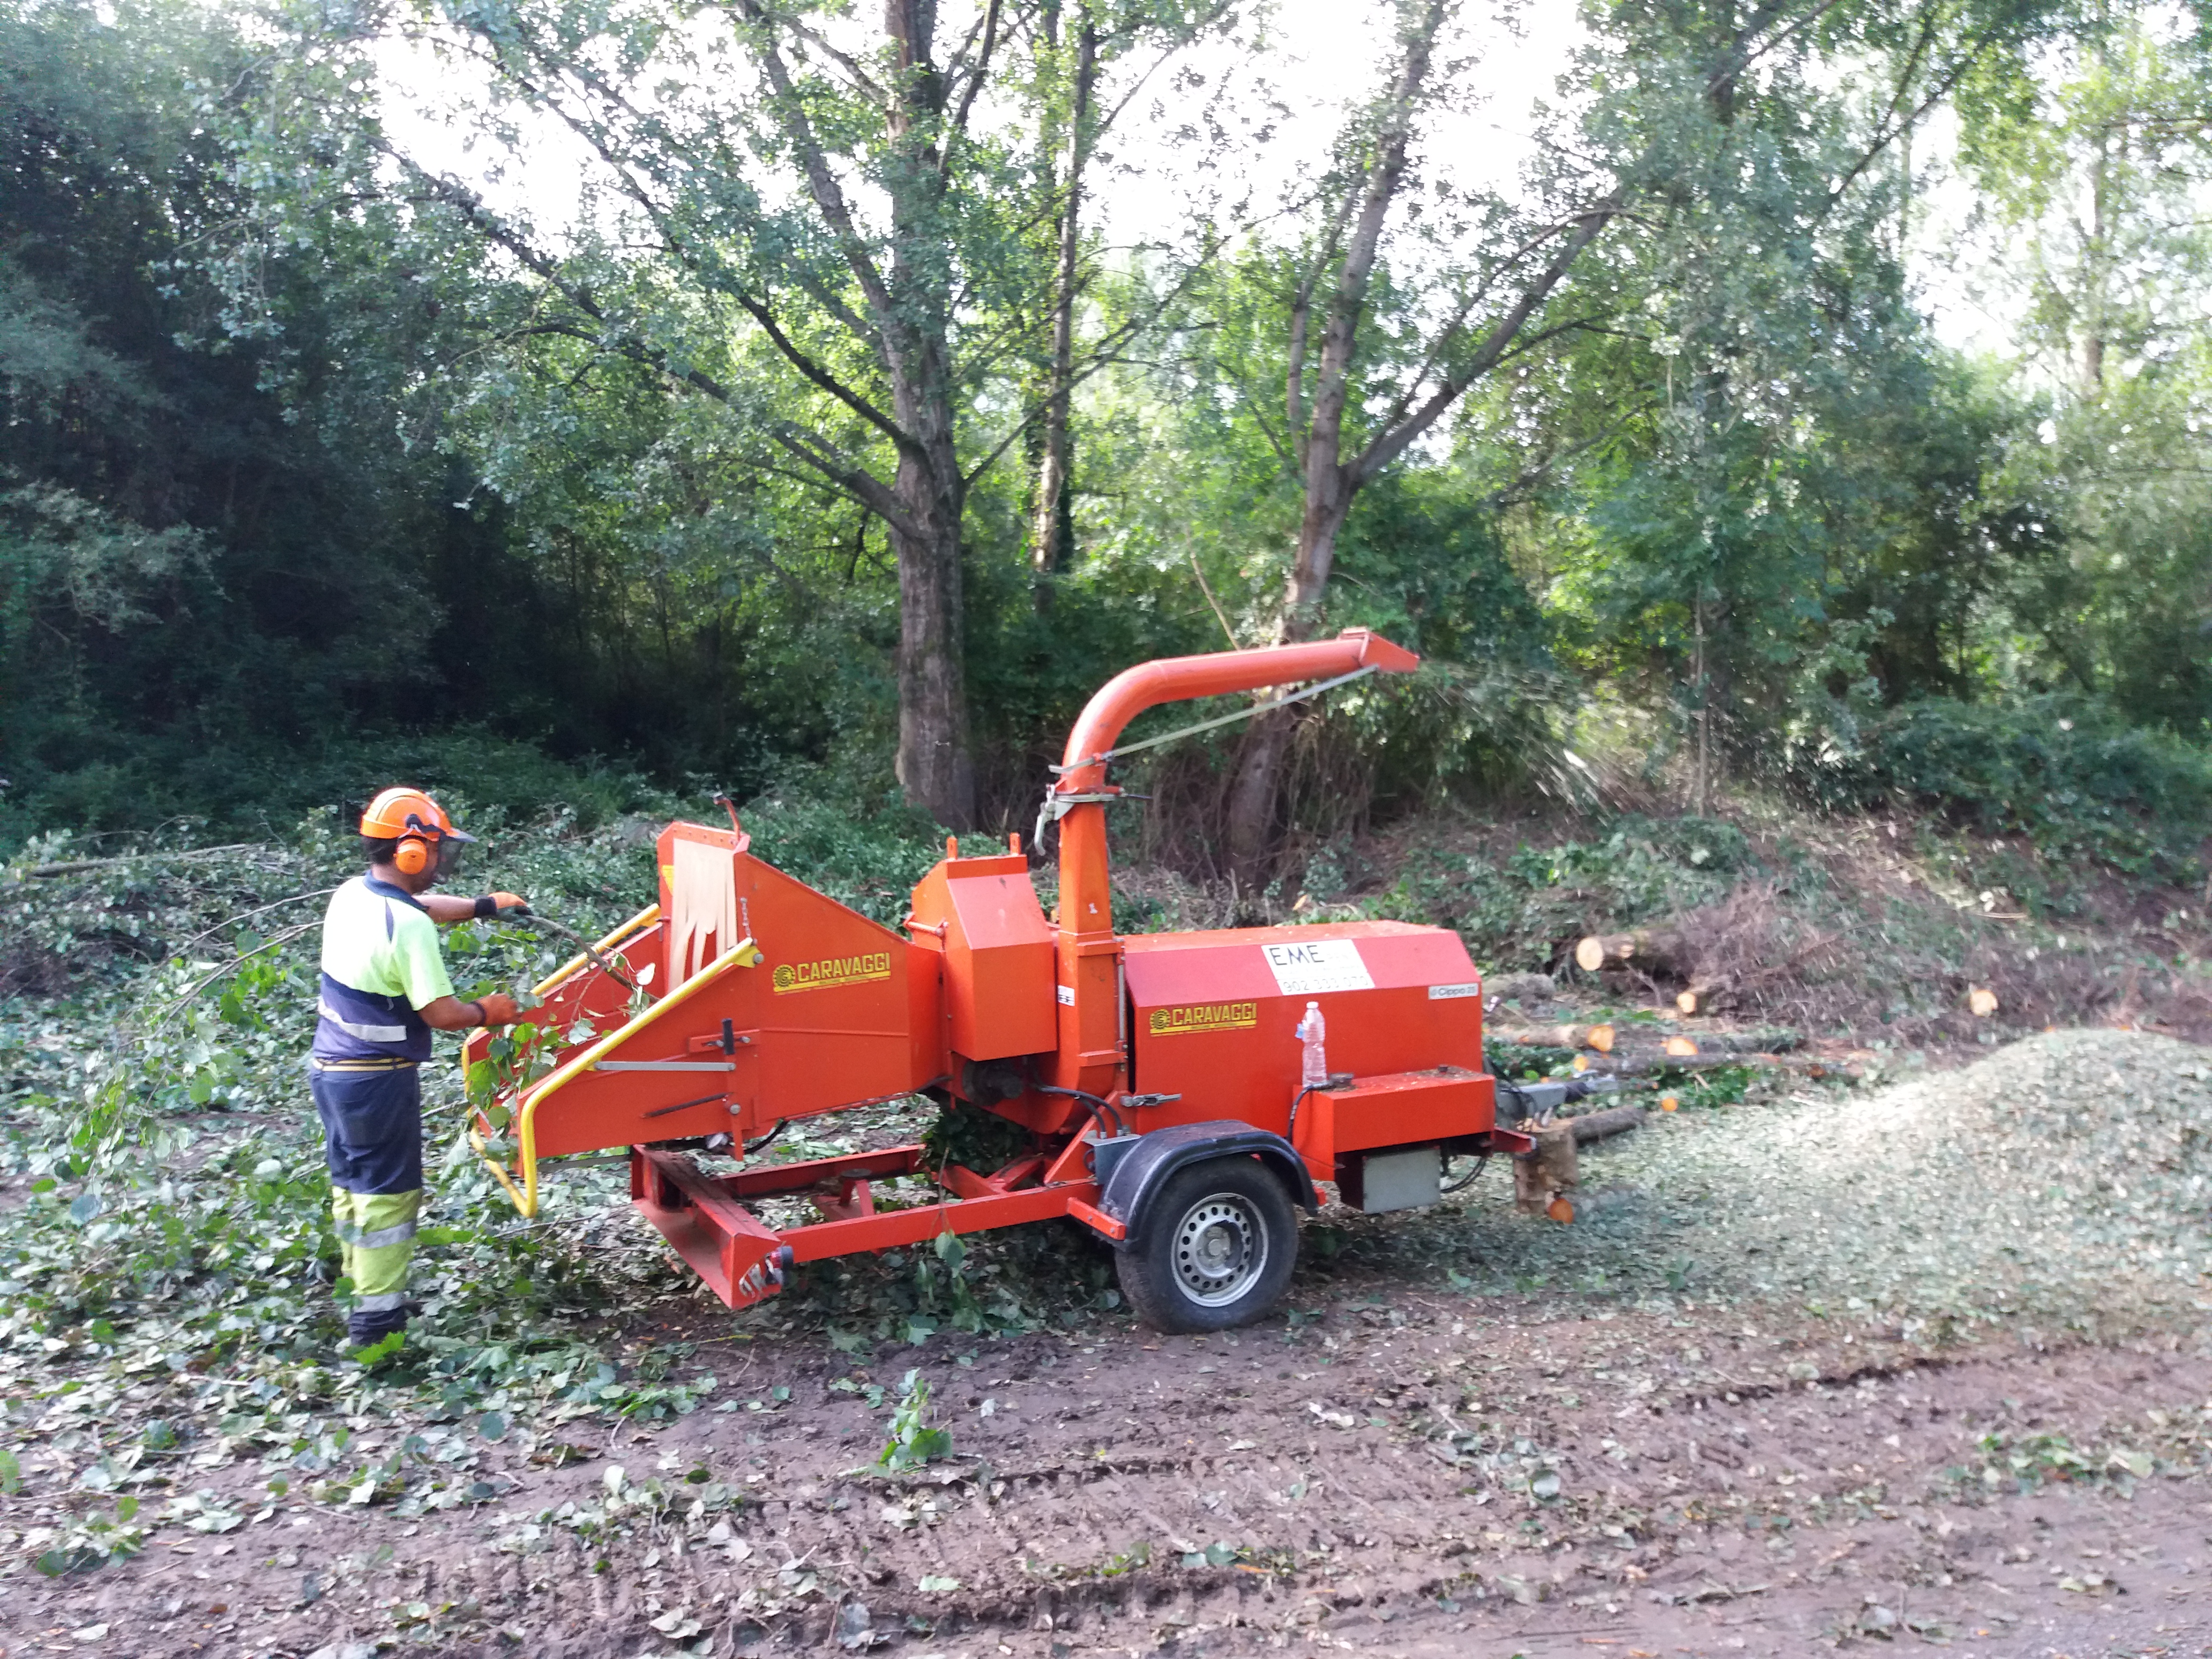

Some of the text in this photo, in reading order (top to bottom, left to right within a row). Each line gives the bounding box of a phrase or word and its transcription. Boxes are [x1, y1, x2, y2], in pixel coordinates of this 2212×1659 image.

[1268, 944, 1325, 966] EME
[797, 952, 890, 982] CARAVAGGI
[1283, 975, 1369, 992] 902 333 070
[1172, 1003, 1257, 1026] CARAVAGGI
